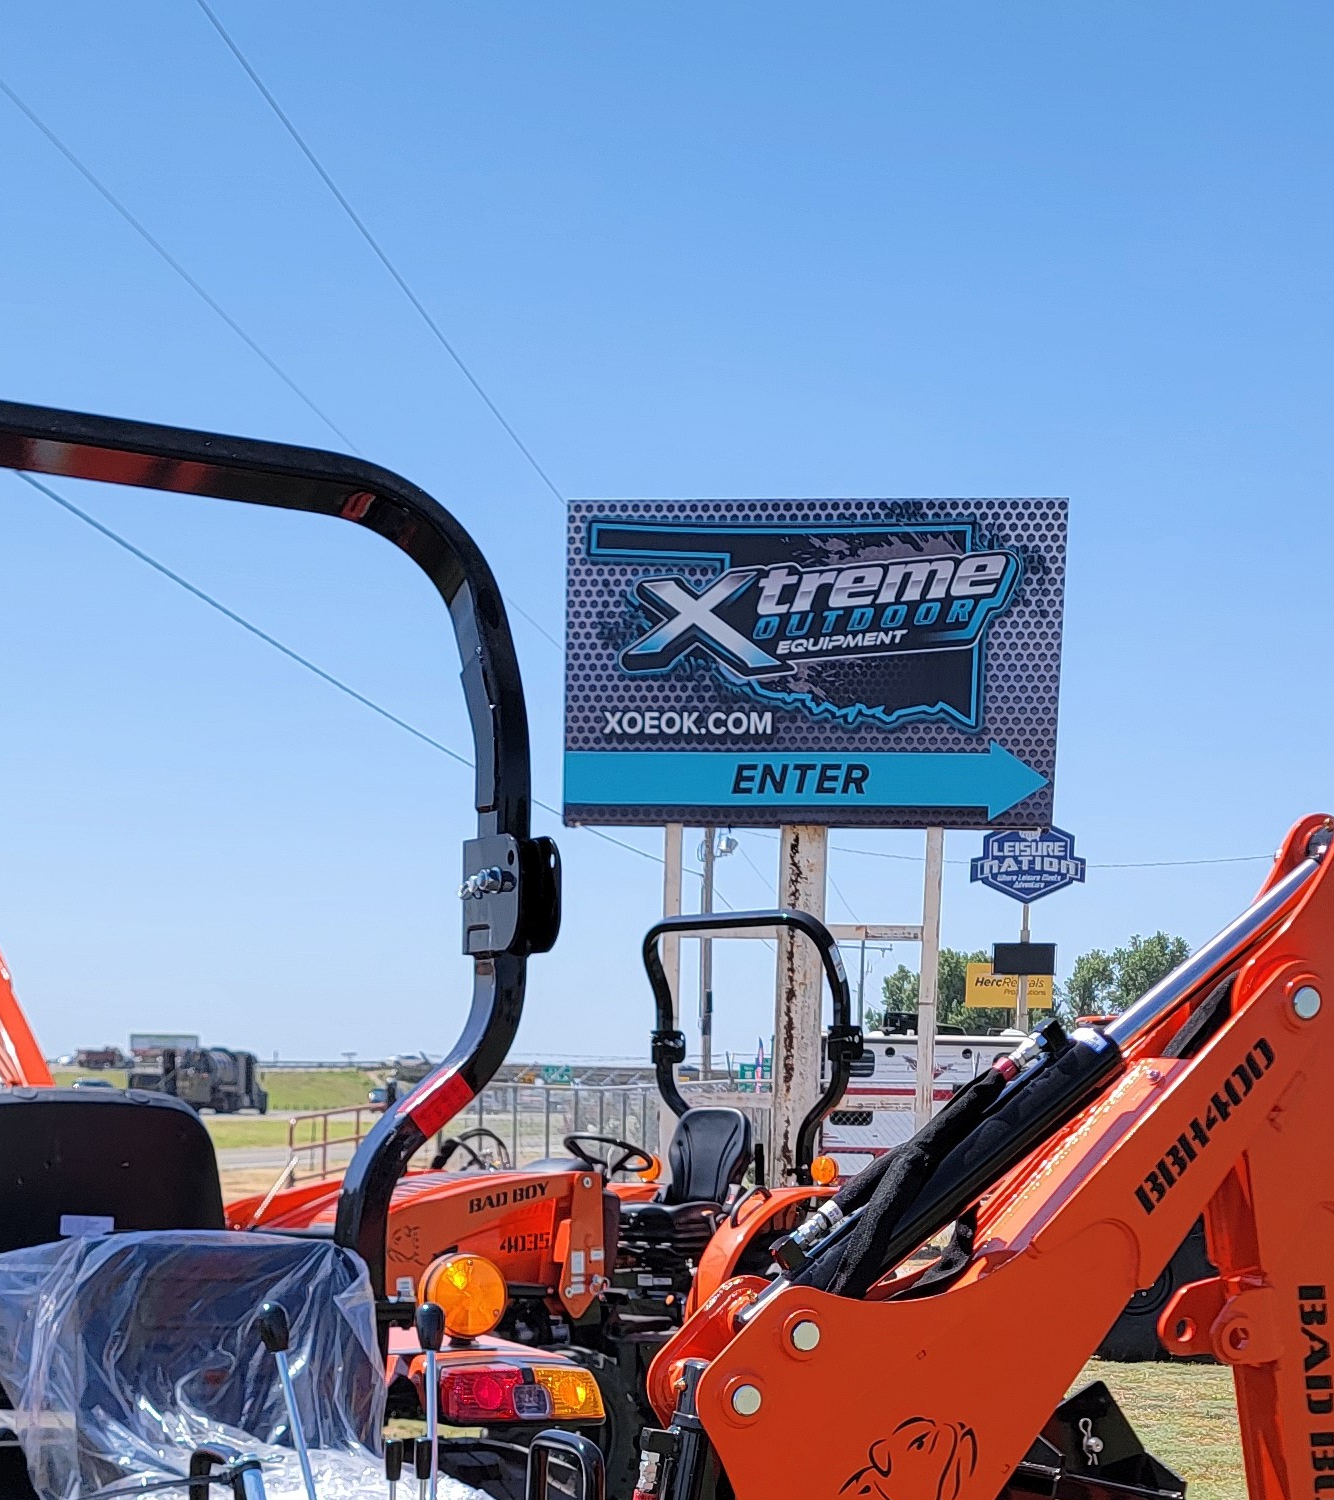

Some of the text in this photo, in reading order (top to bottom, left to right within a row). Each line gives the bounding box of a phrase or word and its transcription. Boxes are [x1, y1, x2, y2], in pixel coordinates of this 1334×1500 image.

[627, 555, 1008, 672] Xtreme
[752, 598, 976, 640] OUTDOOR
[775, 628, 909, 655] EQUIPMENT
[602, 710, 774, 736] XOEOK.COM
[730, 762, 871, 795] ENTER
[992, 841, 1067, 857] LEISURE
[974, 976, 1045, 989] HercReals
[1134, 1036, 1277, 1215] BBH400
[470, 1182, 549, 1213] BAD BOY
[499, 1231, 551, 1254] 4035
[1298, 1285, 1334, 1416] BAD
